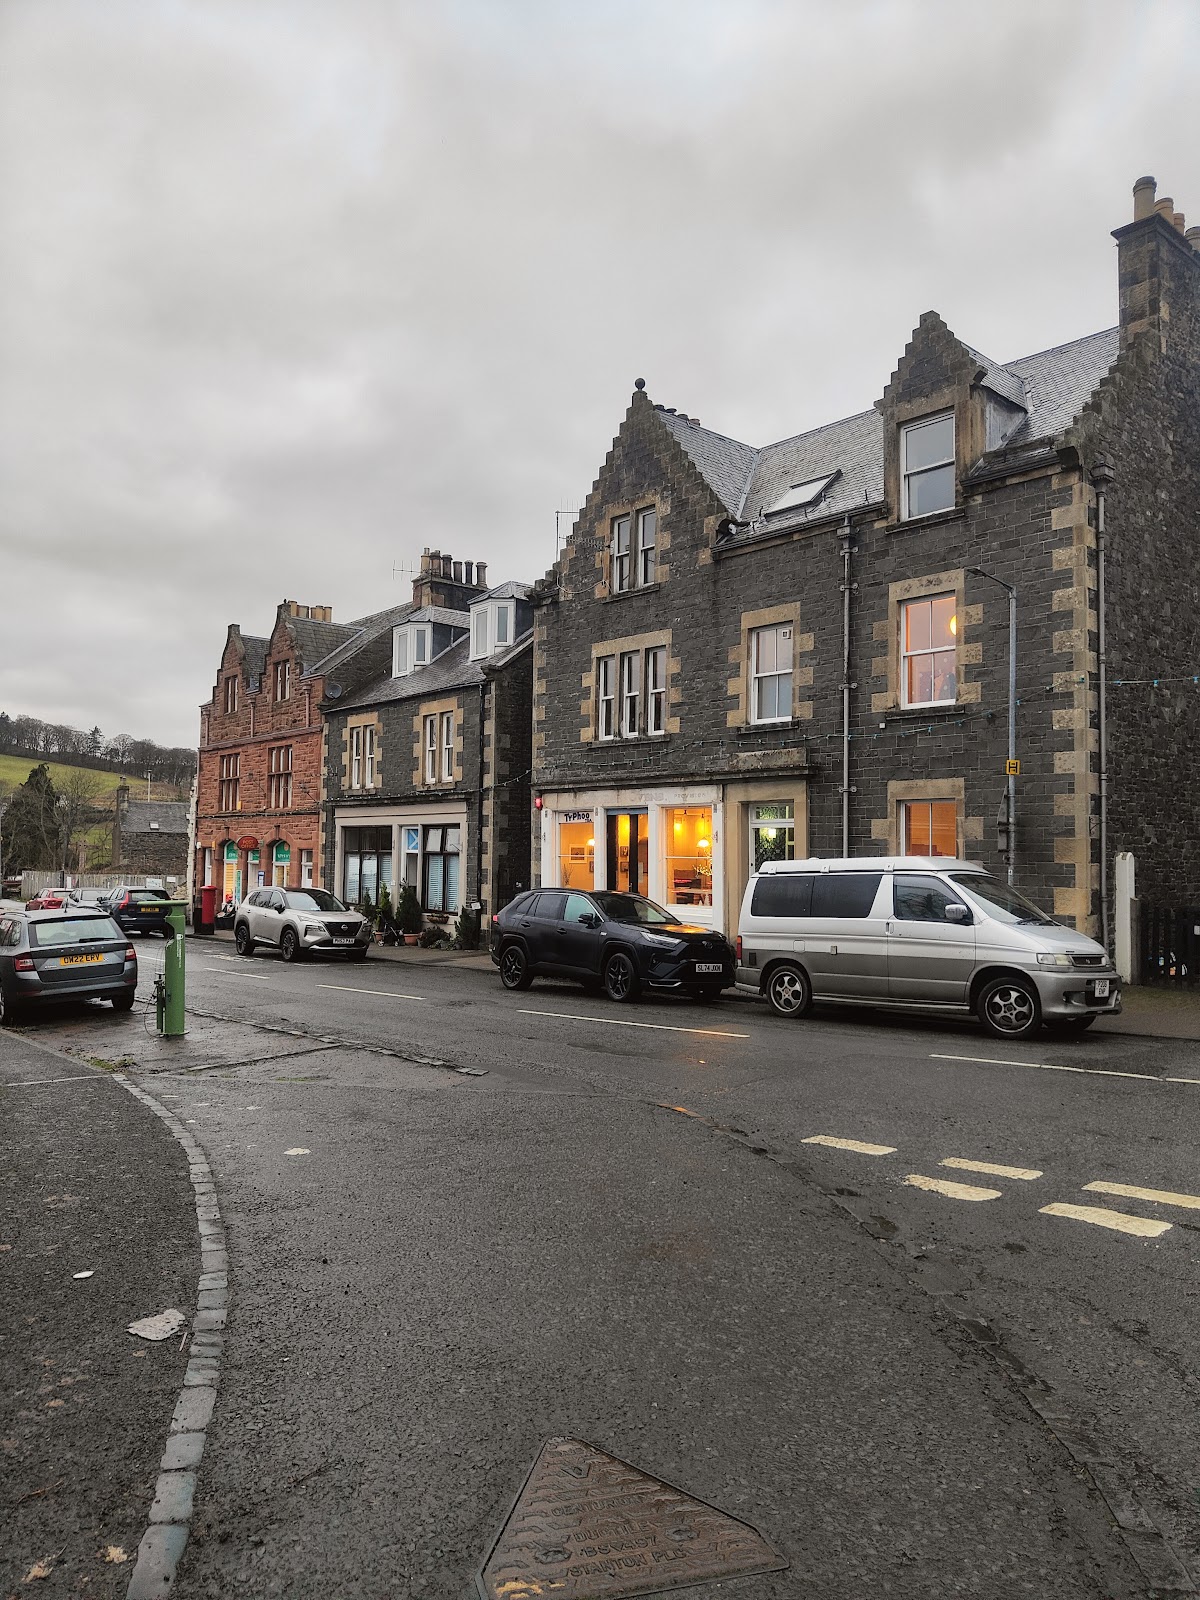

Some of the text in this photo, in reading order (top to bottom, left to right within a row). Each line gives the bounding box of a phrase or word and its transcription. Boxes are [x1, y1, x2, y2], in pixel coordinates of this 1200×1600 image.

[1008, 761, 1018, 773] H
[697, 964, 710, 972] SL74
[569, 1552, 648, 1577] STANTON
